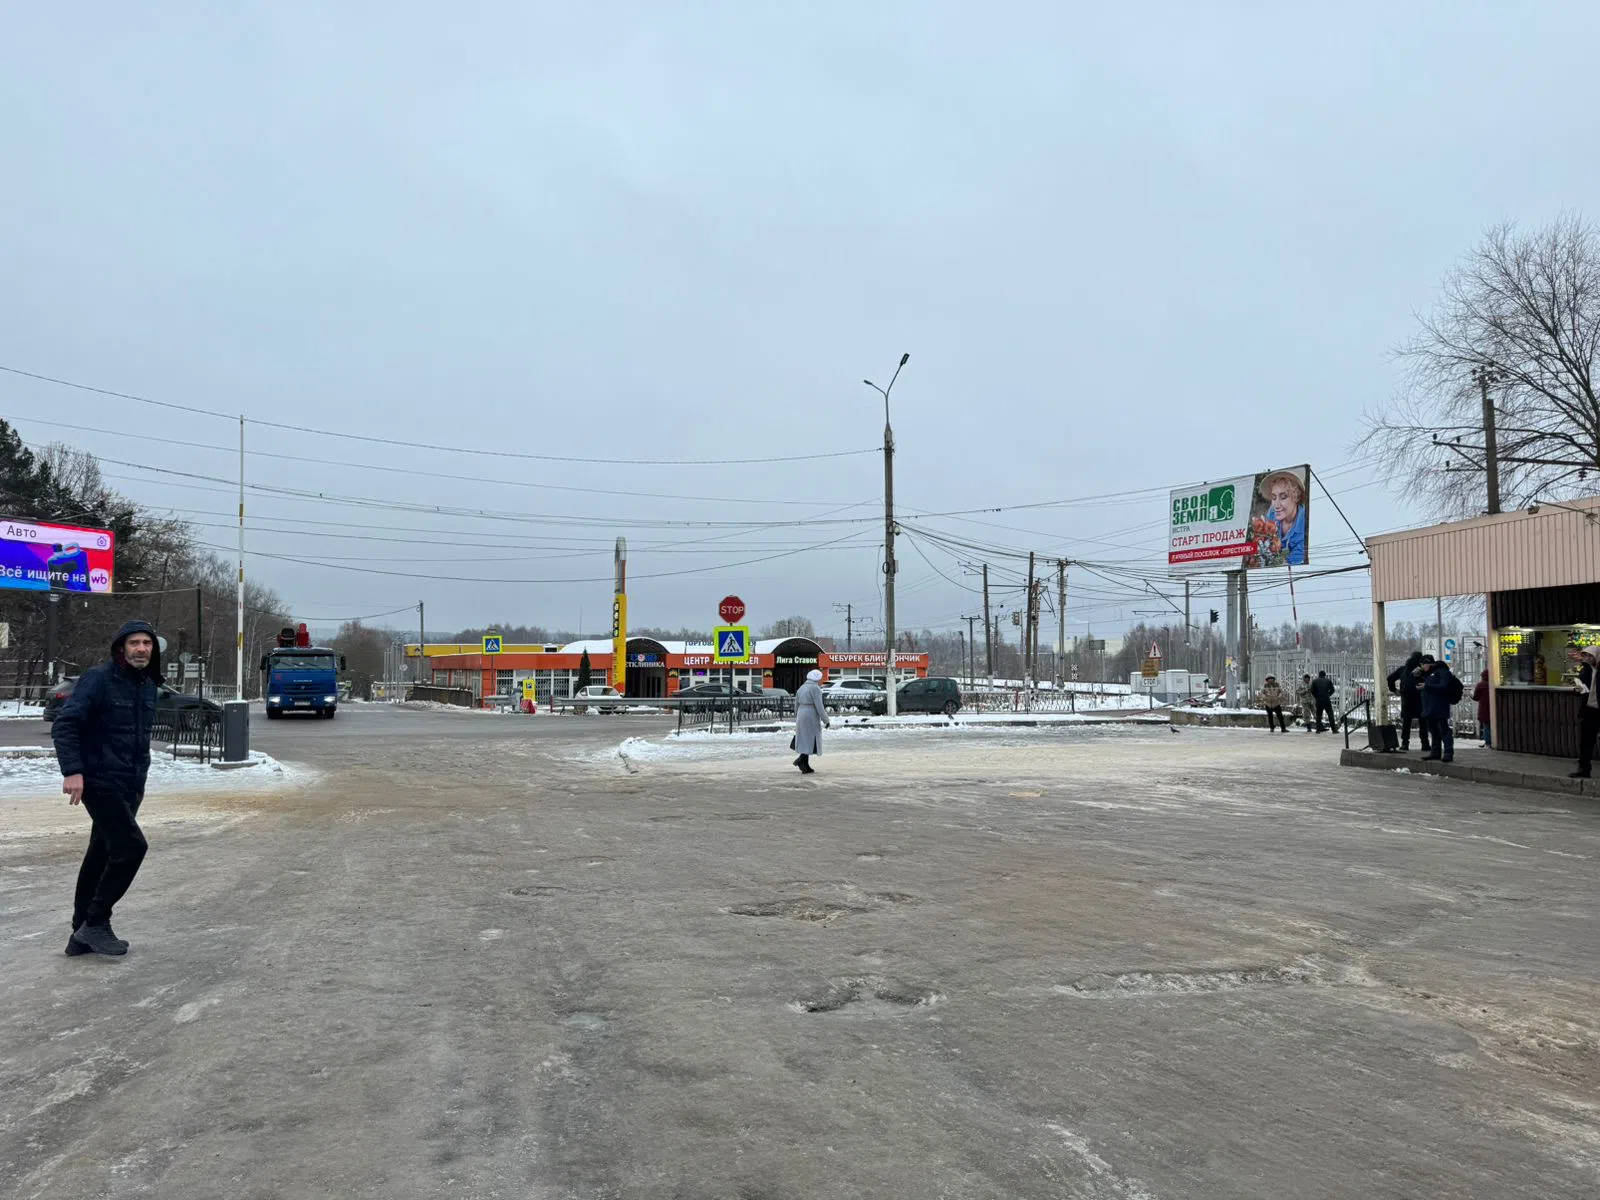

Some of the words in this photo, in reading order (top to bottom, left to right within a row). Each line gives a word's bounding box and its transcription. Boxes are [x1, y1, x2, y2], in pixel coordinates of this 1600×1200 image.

[1173, 493, 1208, 512] СВОЯ
[1173, 505, 1218, 525] ЗЕМЛЯ
[7, 525, 37, 539] Авто
[1172, 535, 1200, 547] СТАРТ
[1202, 528, 1246, 542] ПРОДАЖ
[0, 565, 23, 578] Всё
[27, 569, 69, 581] ищите
[72, 574, 87, 583] на
[91, 574, 108, 585] wb
[720, 605, 744, 615] STOP
[684, 657, 710, 666] ЦЕНТР
[713, 657, 759, 665] АВСЕЛ
[776, 656, 793, 664] Лига
[794, 656, 818, 664] Ставок
